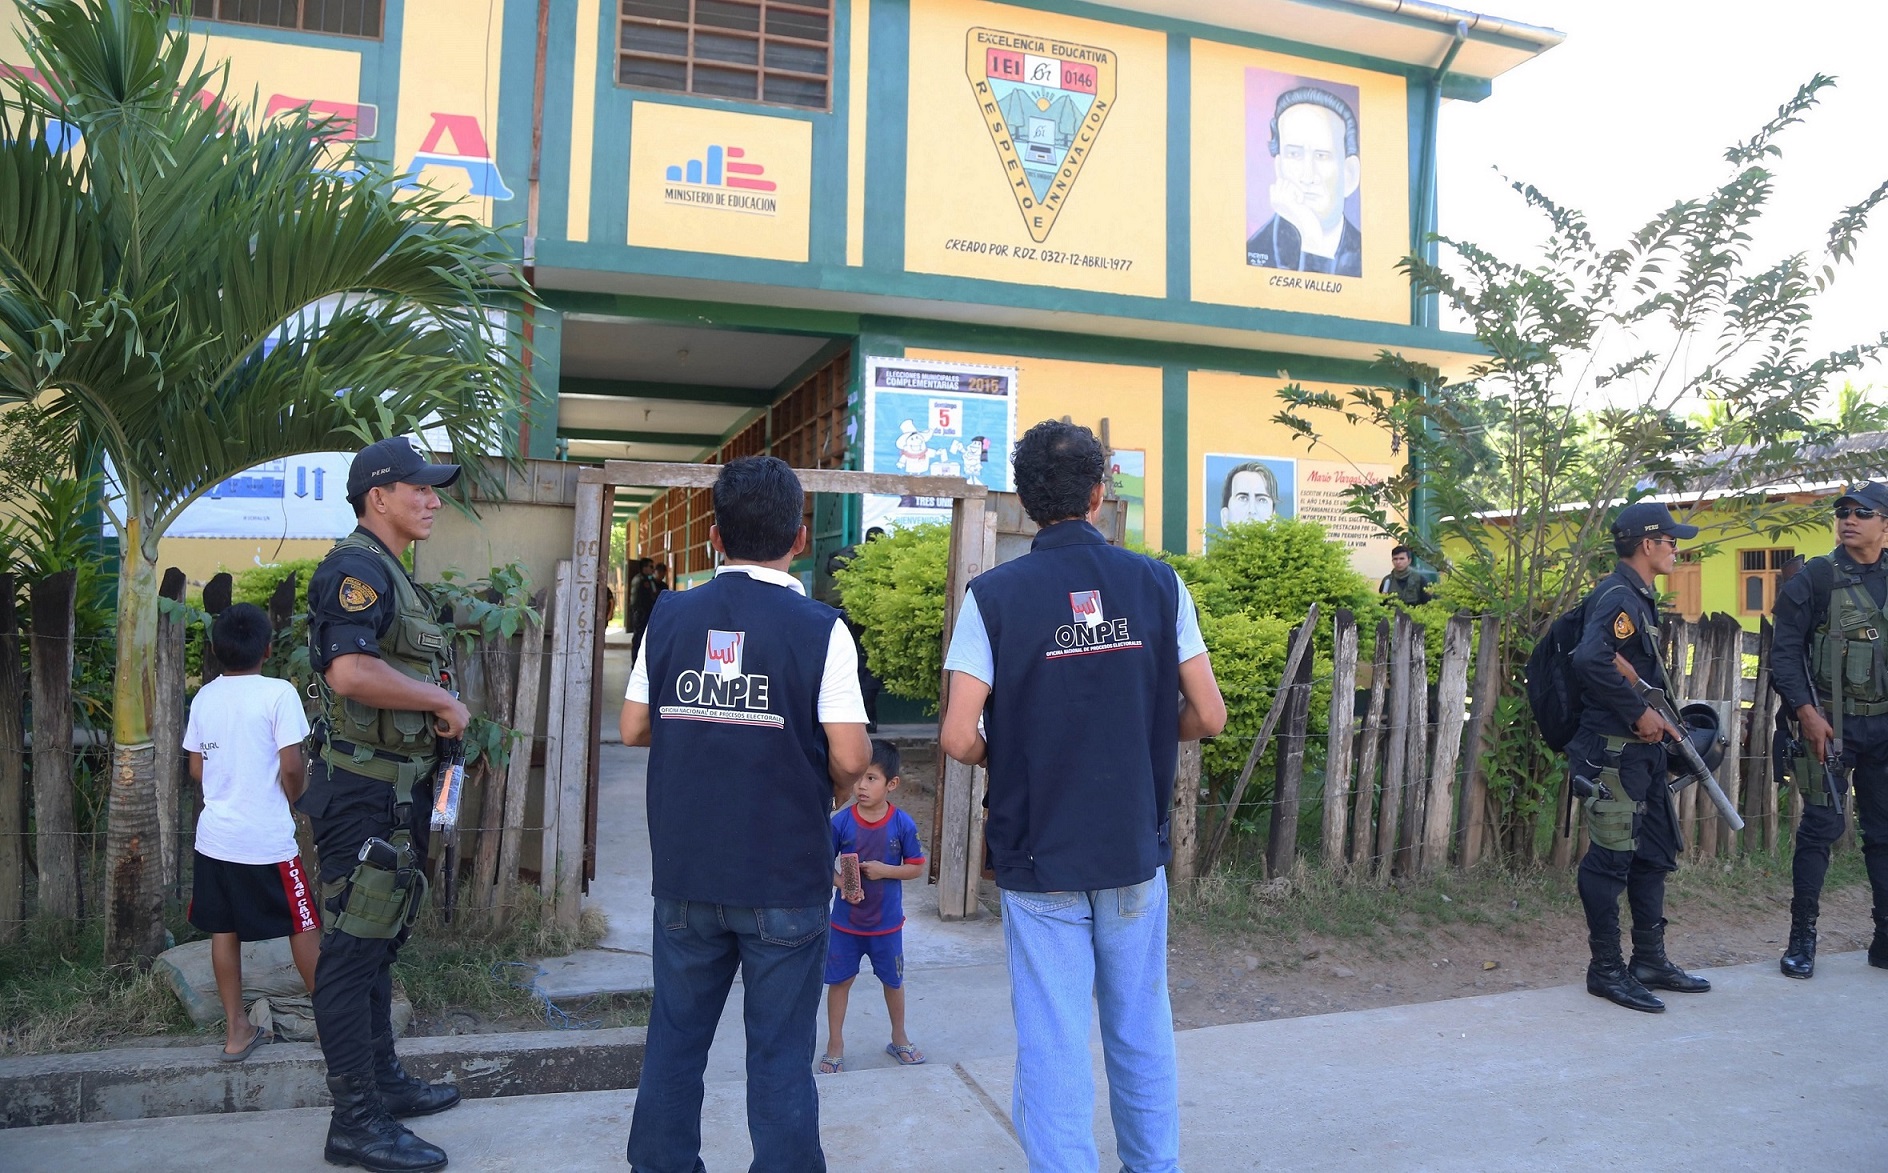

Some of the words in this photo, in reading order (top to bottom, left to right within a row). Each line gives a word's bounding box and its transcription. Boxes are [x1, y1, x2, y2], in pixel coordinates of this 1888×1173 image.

[977, 32, 1045, 53] EXCELENCIA
[1051, 44, 1108, 64] EDUCATIVA
[1065, 70, 1093, 88] 0146
[976, 81, 1033, 209] RESPETO
[1034, 216, 1043, 228] E
[1046, 100, 1107, 211] INNOVACION
[665, 188, 714, 204] MINISTERIO
[715, 193, 726, 206] DE
[728, 194, 777, 212] EDUCACION
[945, 239, 987, 254] CREADO
[988, 243, 1009, 257] POR
[1269, 275, 1303, 289] CESAR
[1304, 279, 1343, 293] VALLEJO
[885, 370, 920, 380] ELECCIONES
[921, 372, 960, 382] MUNICIPALES
[885, 377, 960, 390] COMPLEMENTARIAS
[967, 377, 1000, 393] 2015
[939, 408, 950, 428] 5
[371, 467, 391, 478] PERU
[1307, 470, 1332, 483] Mario
[915, 496, 935, 507] TRES
[1300, 506, 1345, 514] HISPANOAMERICA
[1055, 617, 1130, 648] ONPE
[676, 669, 769, 711] ONPE
